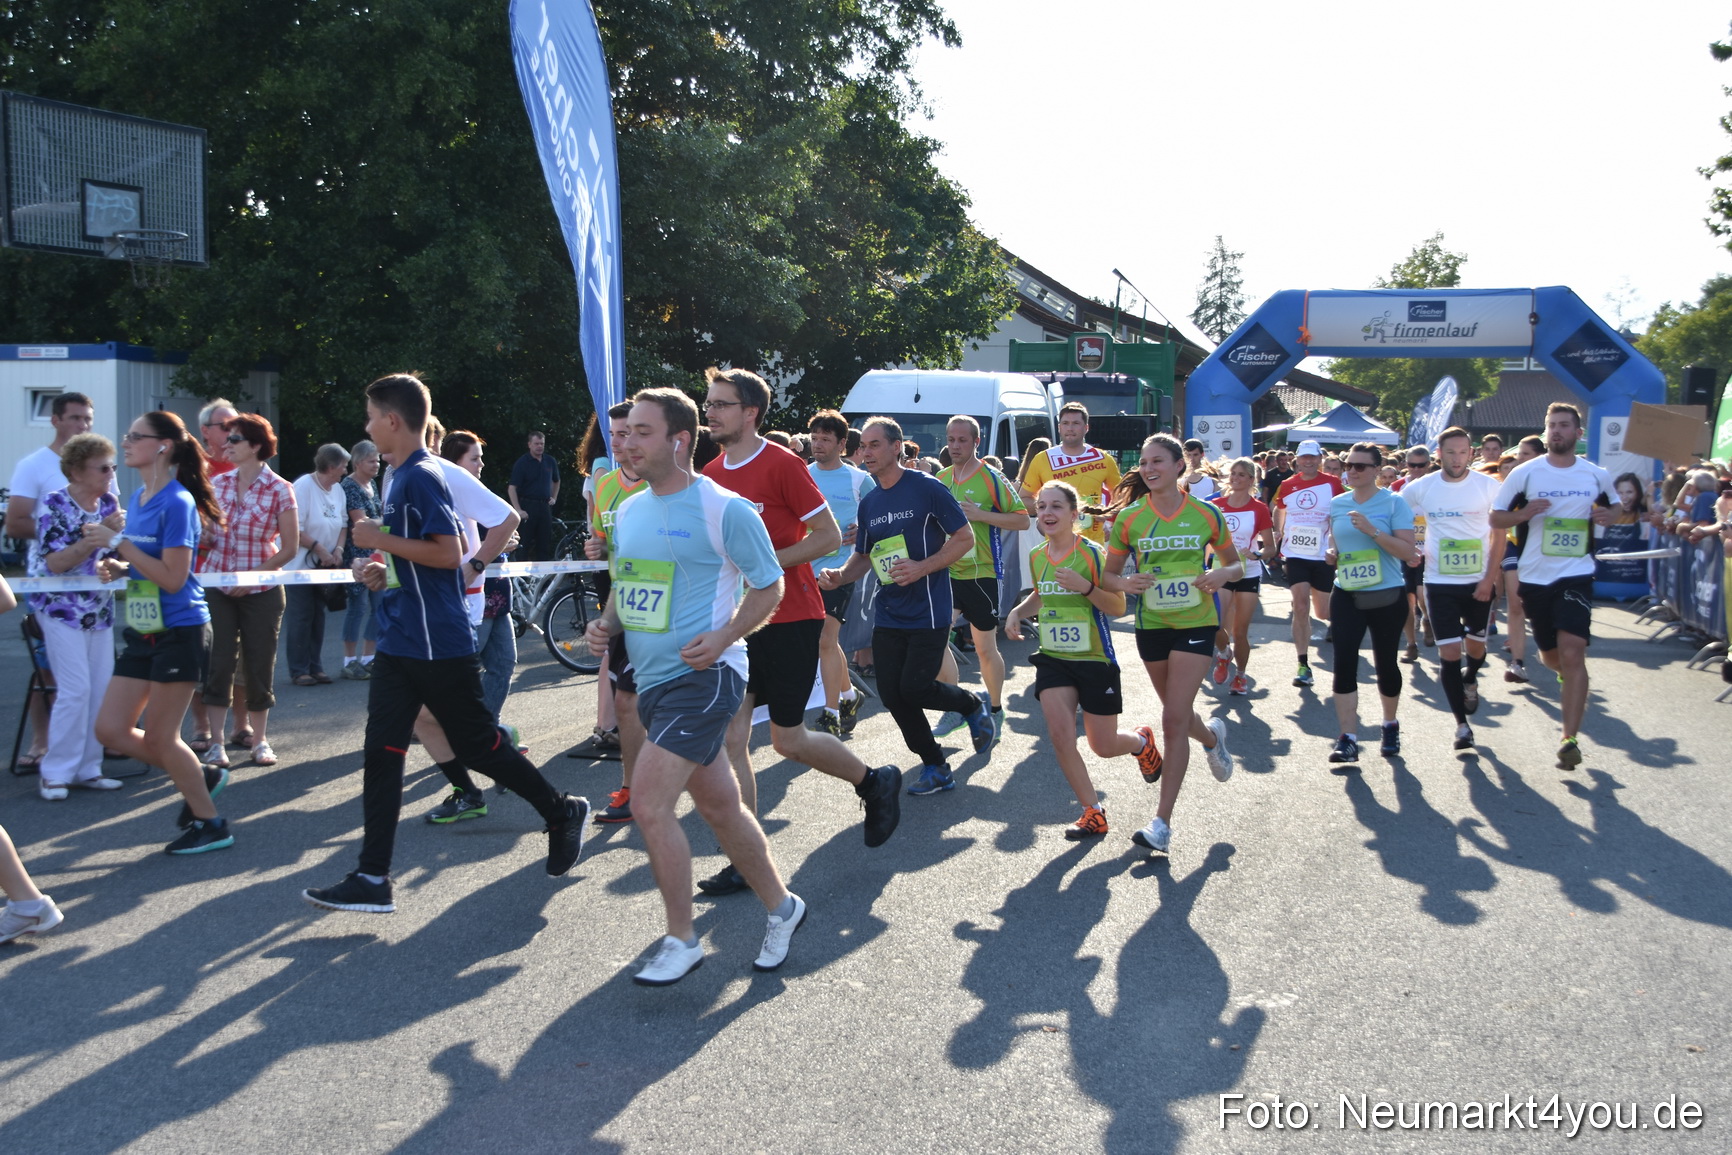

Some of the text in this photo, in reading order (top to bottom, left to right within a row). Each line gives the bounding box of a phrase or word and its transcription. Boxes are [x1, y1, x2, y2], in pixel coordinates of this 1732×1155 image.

[1393, 322, 1479, 338] firmenlauf
[1237, 352, 1280, 361] Fischer
[1053, 462, 1107, 480] MAX BÖGL
[1538, 490, 1591, 498] DELPHI
[870, 509, 914, 527] EURO POLES
[1138, 535, 1201, 552] BOCK
[1291, 535, 1317, 547] 8924
[1551, 533, 1579, 547] 285
[1443, 553, 1477, 566] 1311
[1341, 564, 1377, 580] 1428
[1154, 581, 1189, 599] 149
[618, 586, 664, 613] 1427
[129, 602, 158, 620] 1313
[1049, 626, 1081, 642] 153
